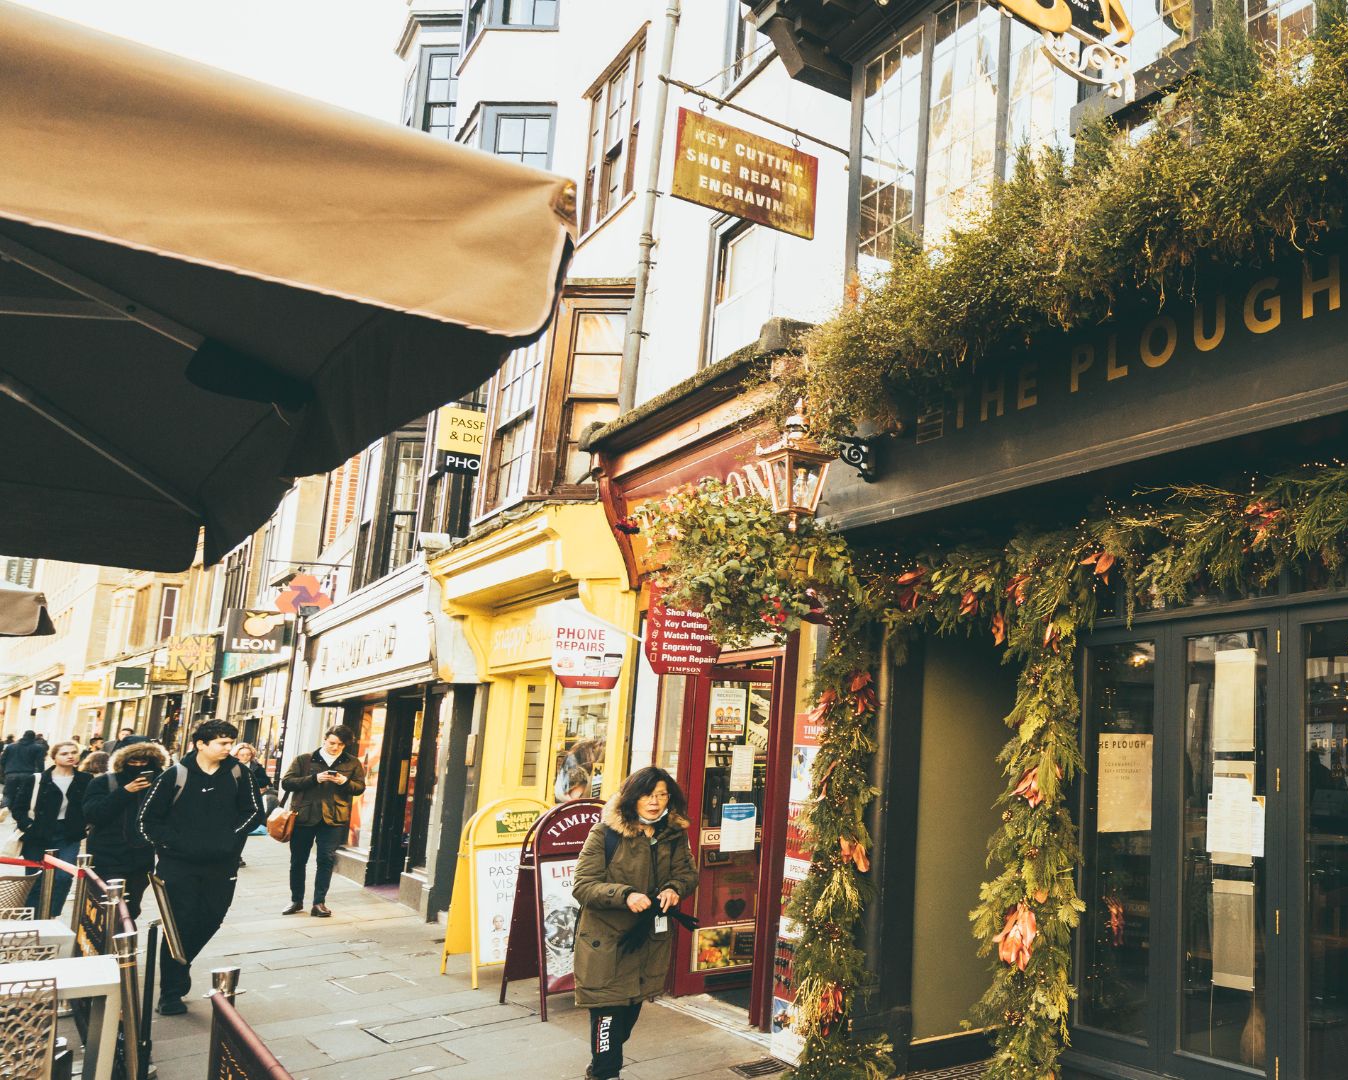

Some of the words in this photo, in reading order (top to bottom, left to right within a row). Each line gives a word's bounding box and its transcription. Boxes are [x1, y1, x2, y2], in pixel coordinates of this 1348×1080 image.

[695, 129, 727, 149] KEY
[735, 143, 804, 178] CUTTING
[686, 148, 731, 174] SHOE
[739, 166, 808, 200] REPAIRS
[699, 175, 795, 216] ENGRAVING
[1071, 255, 1341, 393] PLOUGH
[665, 608, 685, 617] Shoe
[664, 620, 680, 629] Key
[681, 620, 708, 630] Cutting
[556, 627, 606, 640] PHONE
[663, 631, 689, 639] Watch
[231, 638, 276, 651] LEON
[556, 640, 605, 652] REPAIRS
[662, 642, 702, 653] Engraving
[661, 653, 687, 662] Phone
[688, 655, 717, 665] Repairs
[1112, 740, 1146, 749] PLOUGH
[1316, 738, 1337, 748] THE
